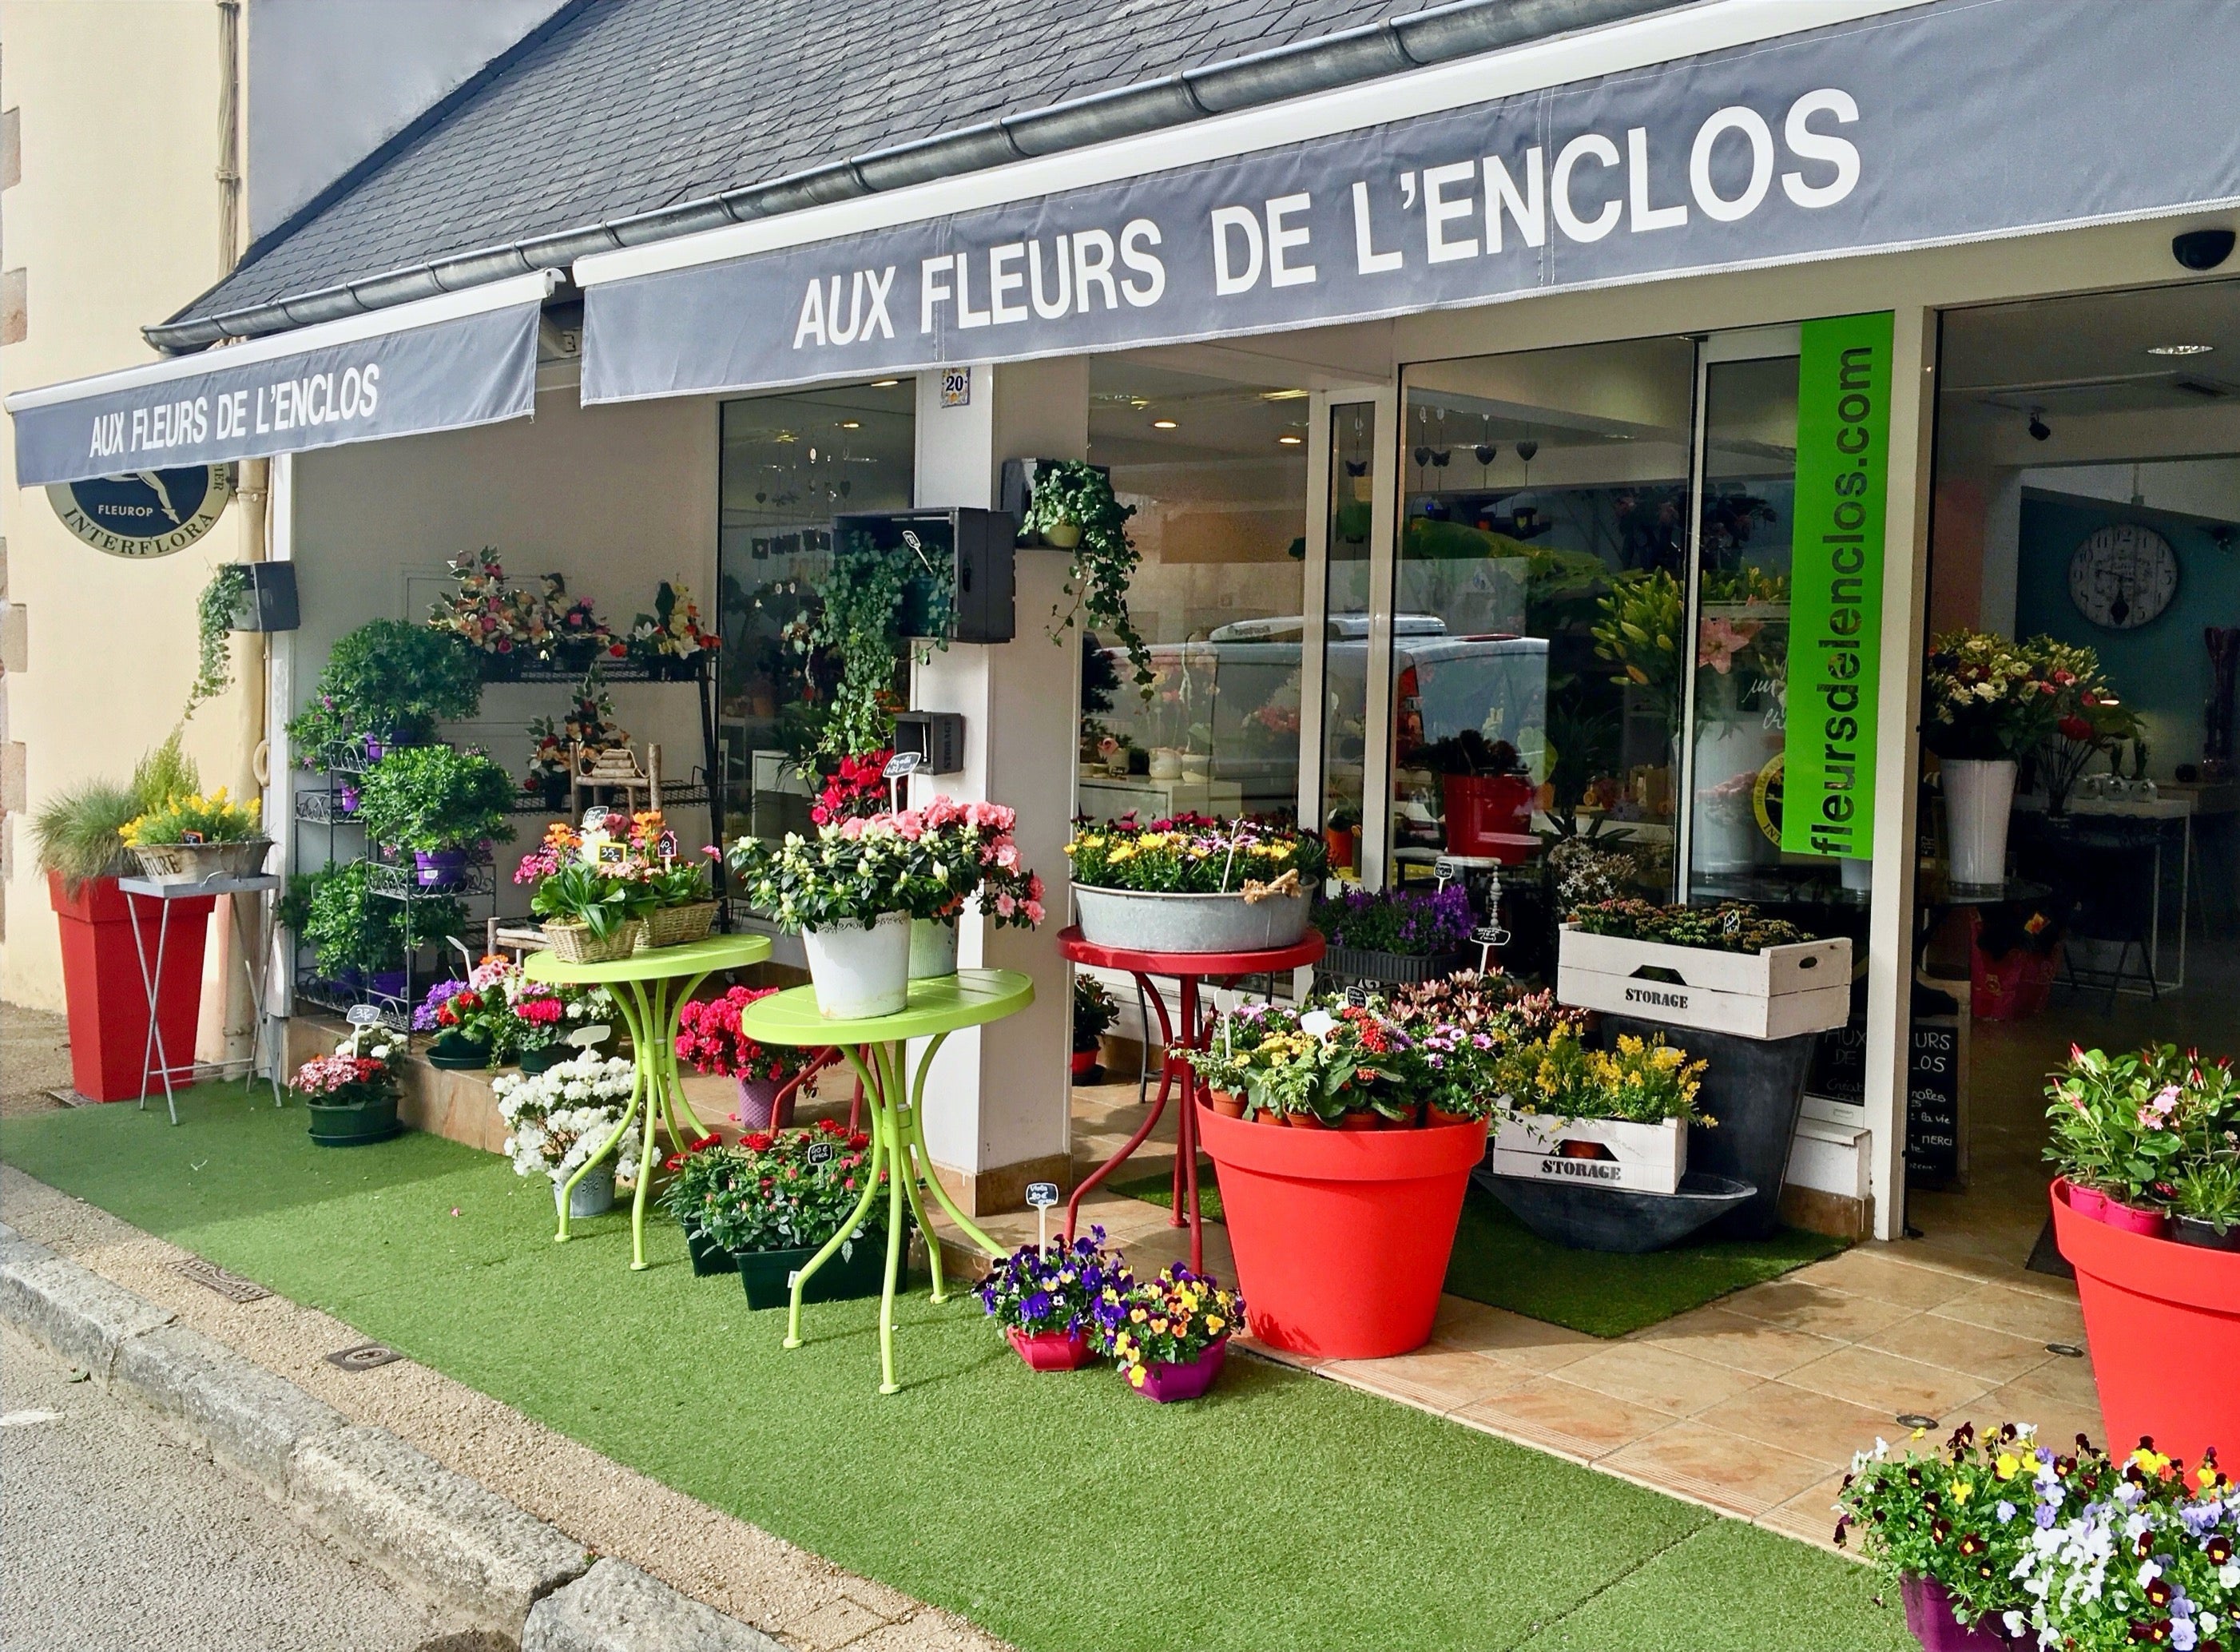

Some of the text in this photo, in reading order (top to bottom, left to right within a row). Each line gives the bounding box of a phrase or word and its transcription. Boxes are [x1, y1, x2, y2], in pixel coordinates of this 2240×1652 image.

[792, 88, 1861, 350] AUX FLEURS DE L'ENCLOS
[946, 375, 963, 391] 20
[89, 363, 379, 458] AUX FLEURS DE L'ENCLOS
[212, 464, 224, 490] IER
[97, 504, 153, 517] FLEUROP
[62, 508, 214, 555] INTERFLORA
[1810, 345, 1873, 855] fleursdelenclos.com
[1626, 987, 1689, 1009] STORAGE
[1542, 1159, 1621, 1181] STORAGE
